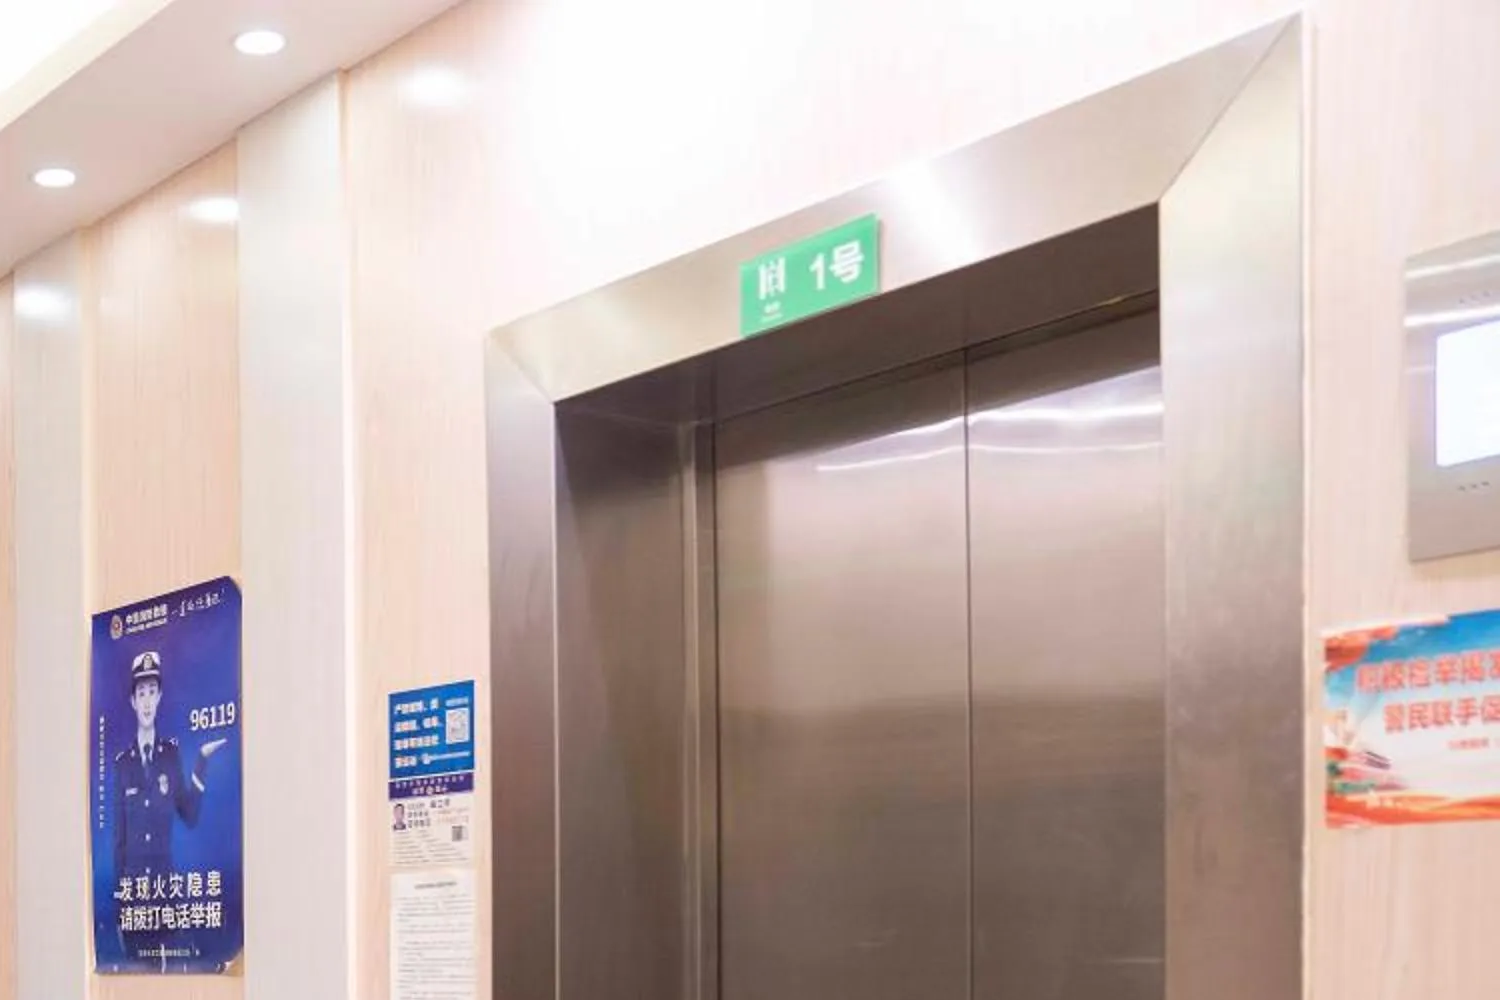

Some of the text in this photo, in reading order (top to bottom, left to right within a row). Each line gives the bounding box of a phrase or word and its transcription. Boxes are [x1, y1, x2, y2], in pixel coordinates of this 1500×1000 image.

[808, 239, 865, 291] 1号
[189, 701, 236, 731] 96119
[119, 869, 222, 902] 发现火灾隐患
[119, 901, 222, 932] 请拨打电话举报
